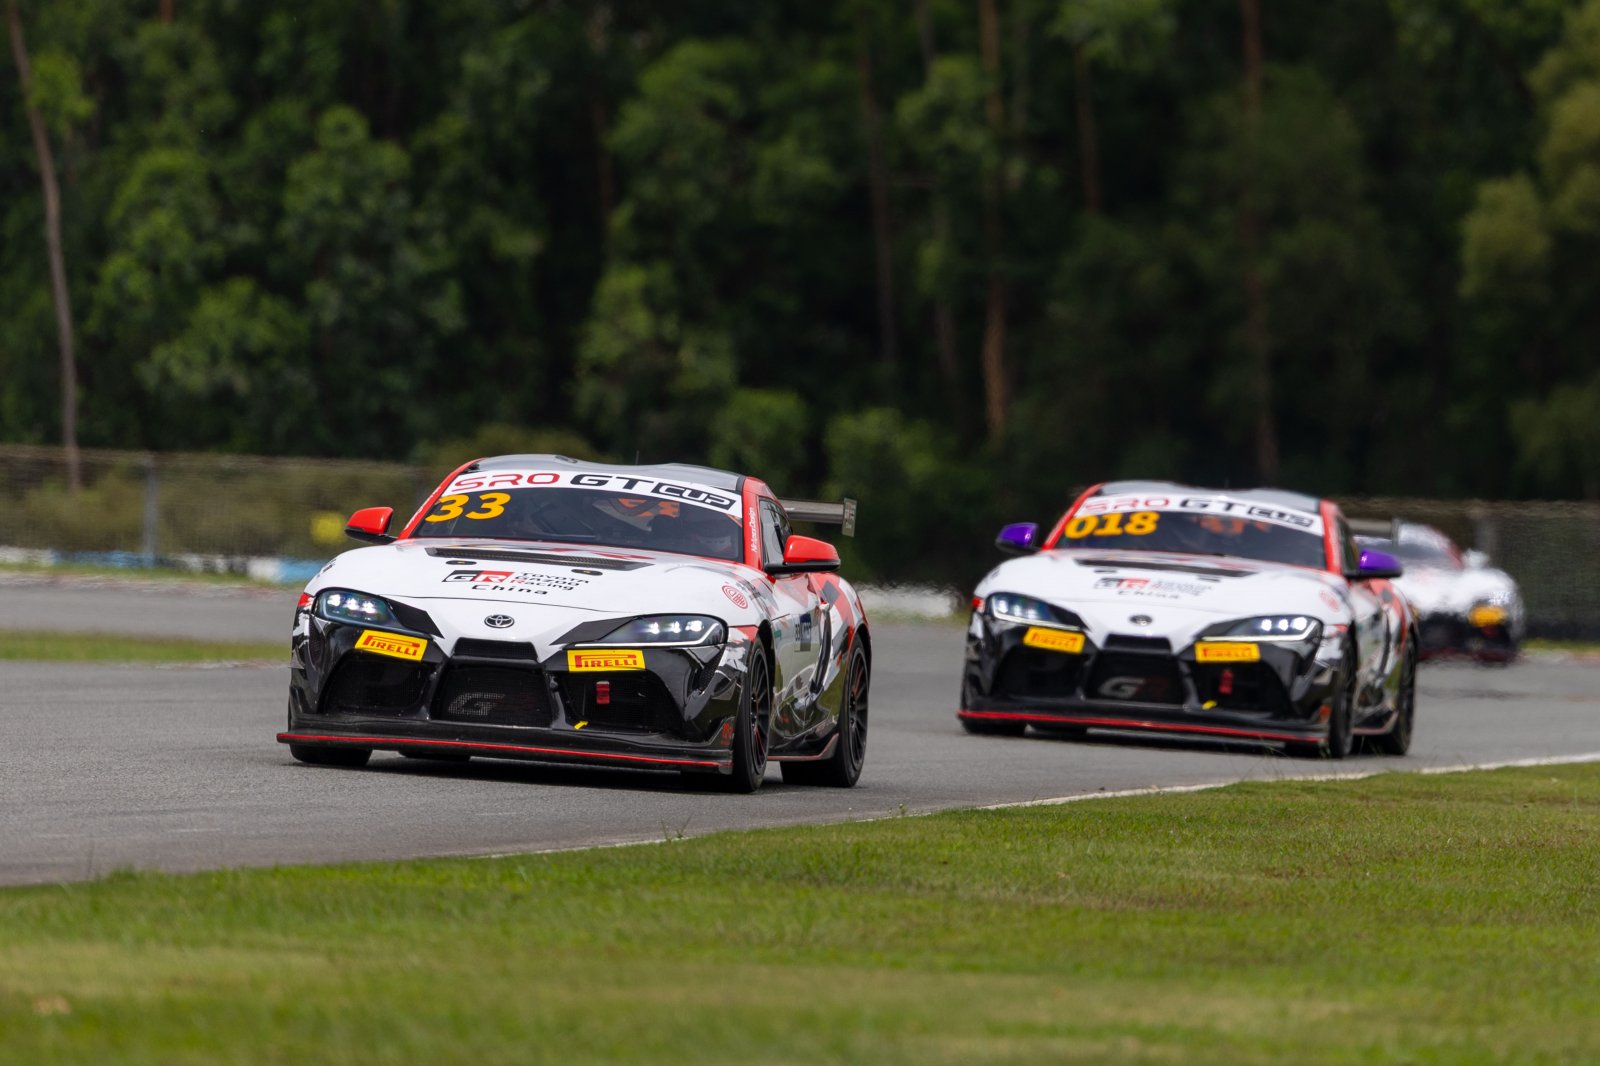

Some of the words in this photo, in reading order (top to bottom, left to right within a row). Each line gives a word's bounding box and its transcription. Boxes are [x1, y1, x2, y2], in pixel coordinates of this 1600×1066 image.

[455, 473, 560, 492] SRO
[570, 474, 647, 490] GT
[656, 484, 734, 508] CUP
[425, 492, 511, 523] 33
[1179, 498, 1247, 513] GT
[1064, 511, 1160, 539] 018
[443, 571, 512, 583] GR
[521, 572, 590, 584] TOYOTA
[471, 584, 548, 595] China
[363, 634, 421, 657] PIRELLI
[575, 653, 638, 669] PIRELLI
